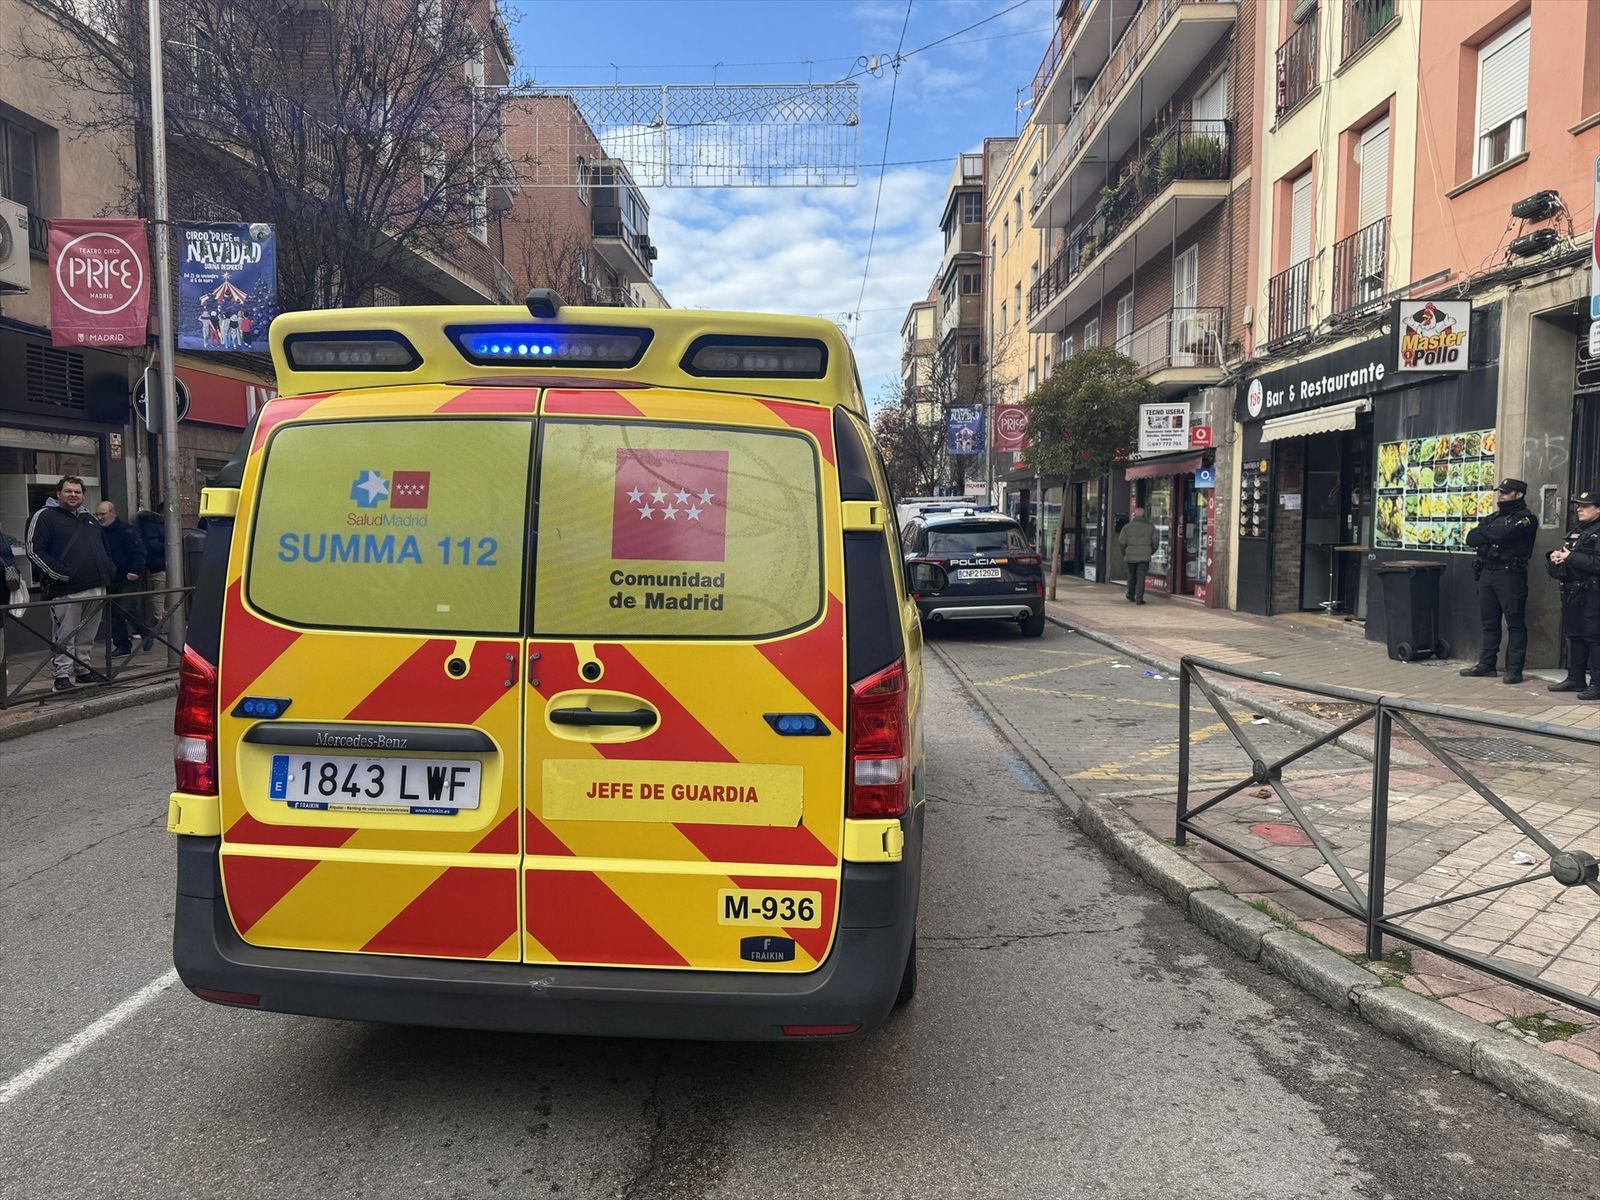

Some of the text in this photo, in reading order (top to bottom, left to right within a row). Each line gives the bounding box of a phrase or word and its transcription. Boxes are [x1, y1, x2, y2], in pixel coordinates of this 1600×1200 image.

[186, 231, 208, 240] CIRCO
[210, 231, 233, 242] PRICE
[186, 241, 262, 264] NAVIDAD
[69, 257, 131, 289] PRICE
[1402, 330, 1467, 353] Master
[1412, 347, 1459, 367] Pollo
[1266, 362, 1384, 408] Bar & Restaurante
[347, 512, 427, 527] SaludMadrid
[278, 533, 498, 566] SUMMA 112
[610, 570, 724, 587] Comunidad
[609, 592, 724, 610] de Madrid
[316, 733, 408, 748] Mercedes-Benz
[275, 782, 282, 791] E
[302, 761, 470, 801] 1843 LWF
[586, 782, 758, 803] JEFE DE GUARDIA
[725, 896, 814, 921] M-936
[764, 939, 771, 950] F
[752, 952, 784, 960] FRAIKIN
